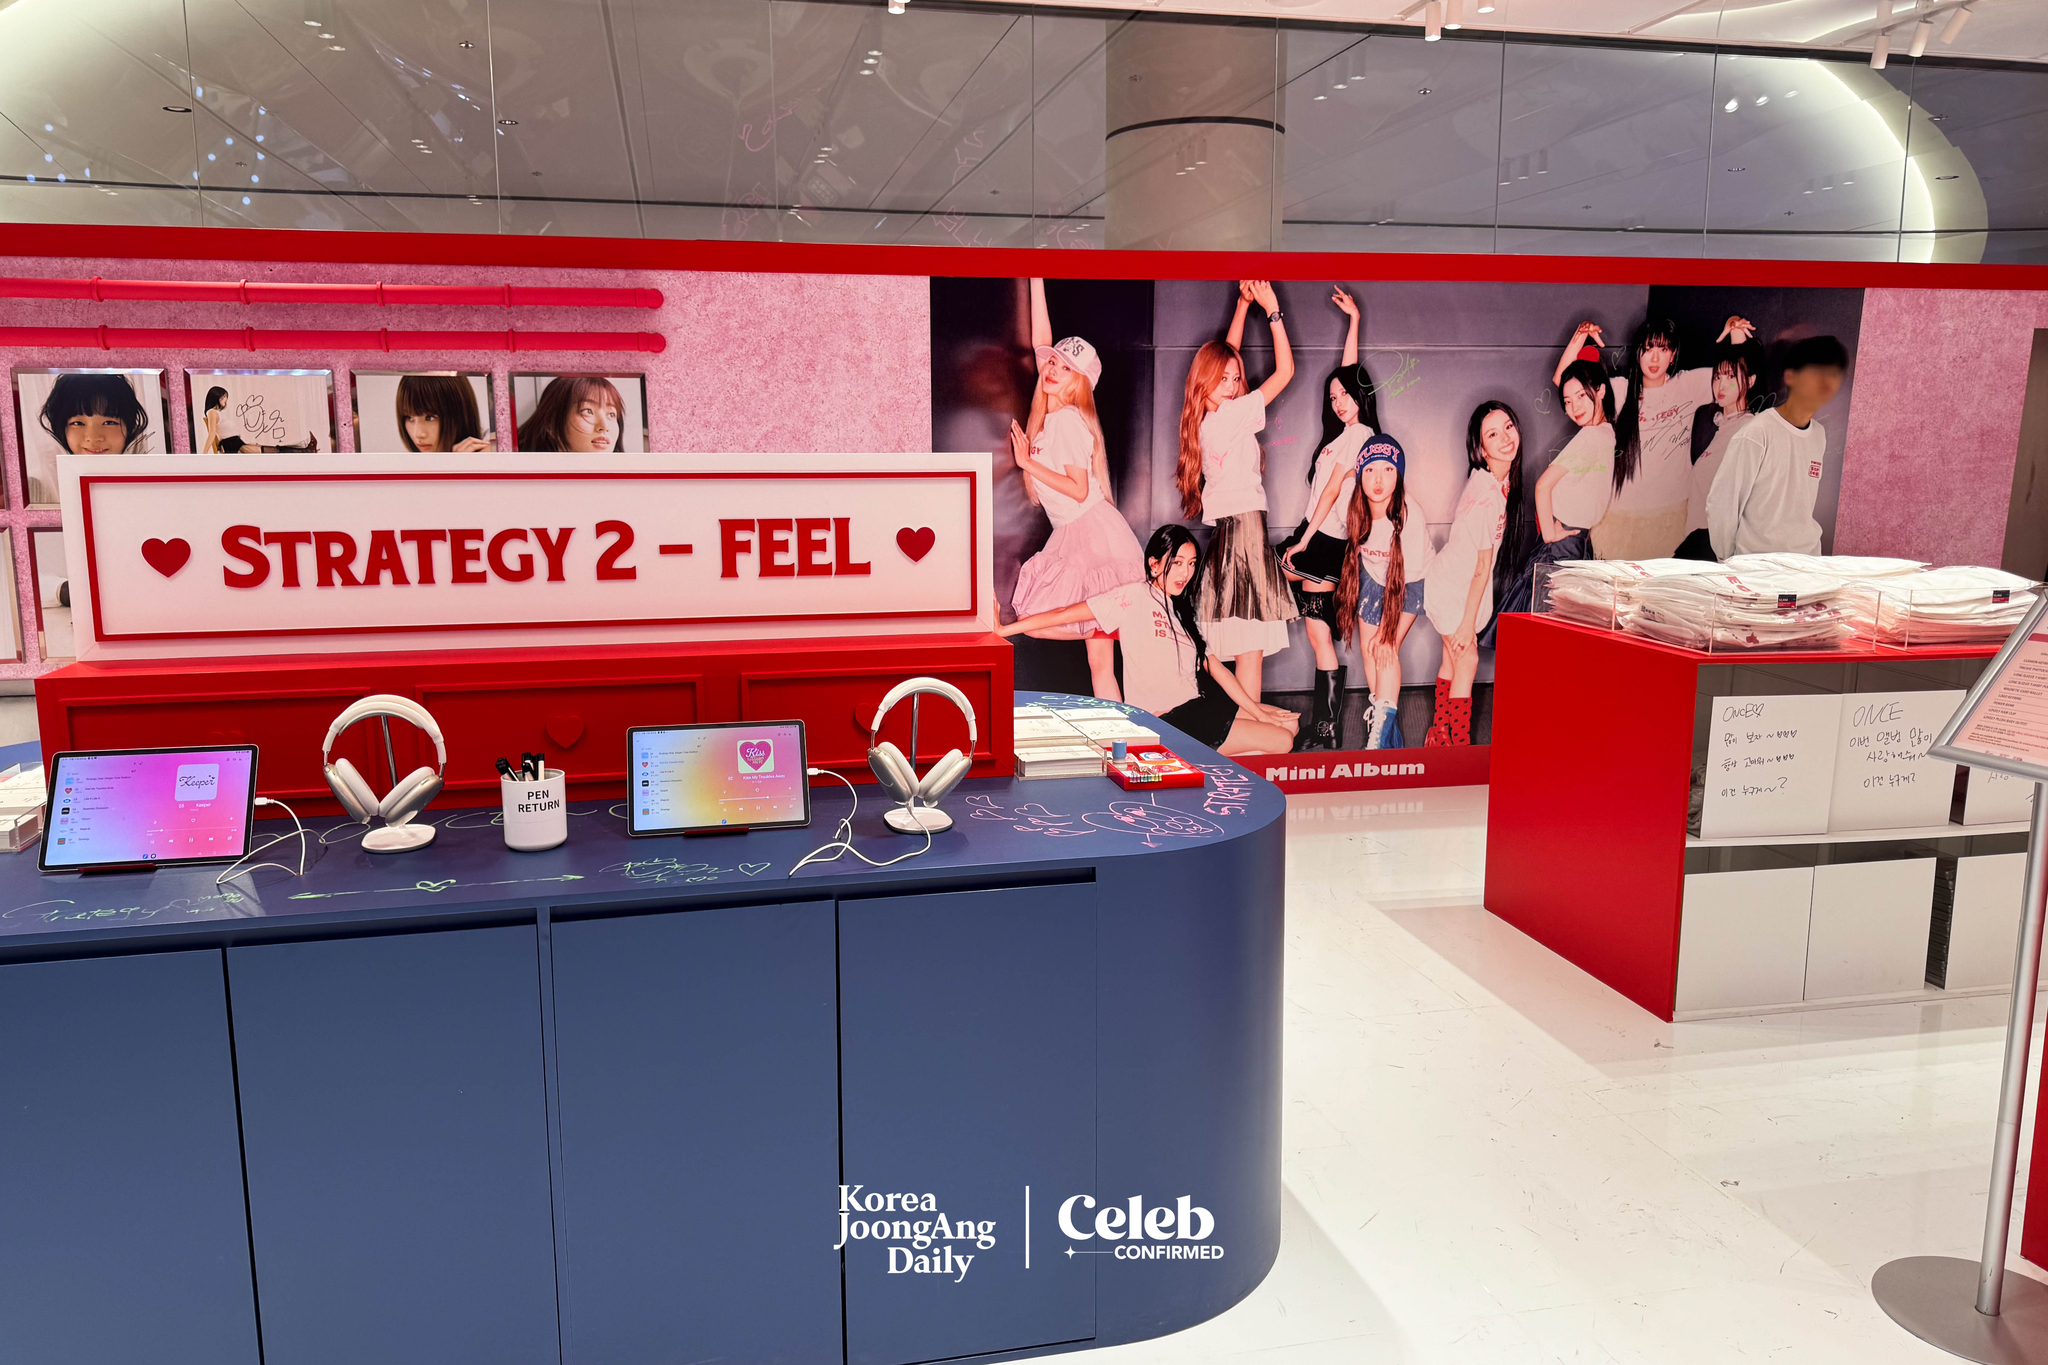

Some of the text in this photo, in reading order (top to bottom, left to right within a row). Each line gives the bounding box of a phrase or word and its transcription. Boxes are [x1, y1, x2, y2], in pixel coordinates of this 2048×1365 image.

[220, 524, 577, 589] STRATEGY
[595, 520, 637, 581] 2
[718, 517, 872, 578] FEEL
[1853, 702, 1903, 727] ONCE
[1849, 735, 1870, 748] 이번
[1909, 727, 1933, 748] 많이
[1265, 763, 1425, 781] Mini Album
[178, 775, 216, 789] Keeper
[527, 789, 550, 801] PEN
[518, 799, 560, 813] RETURN
